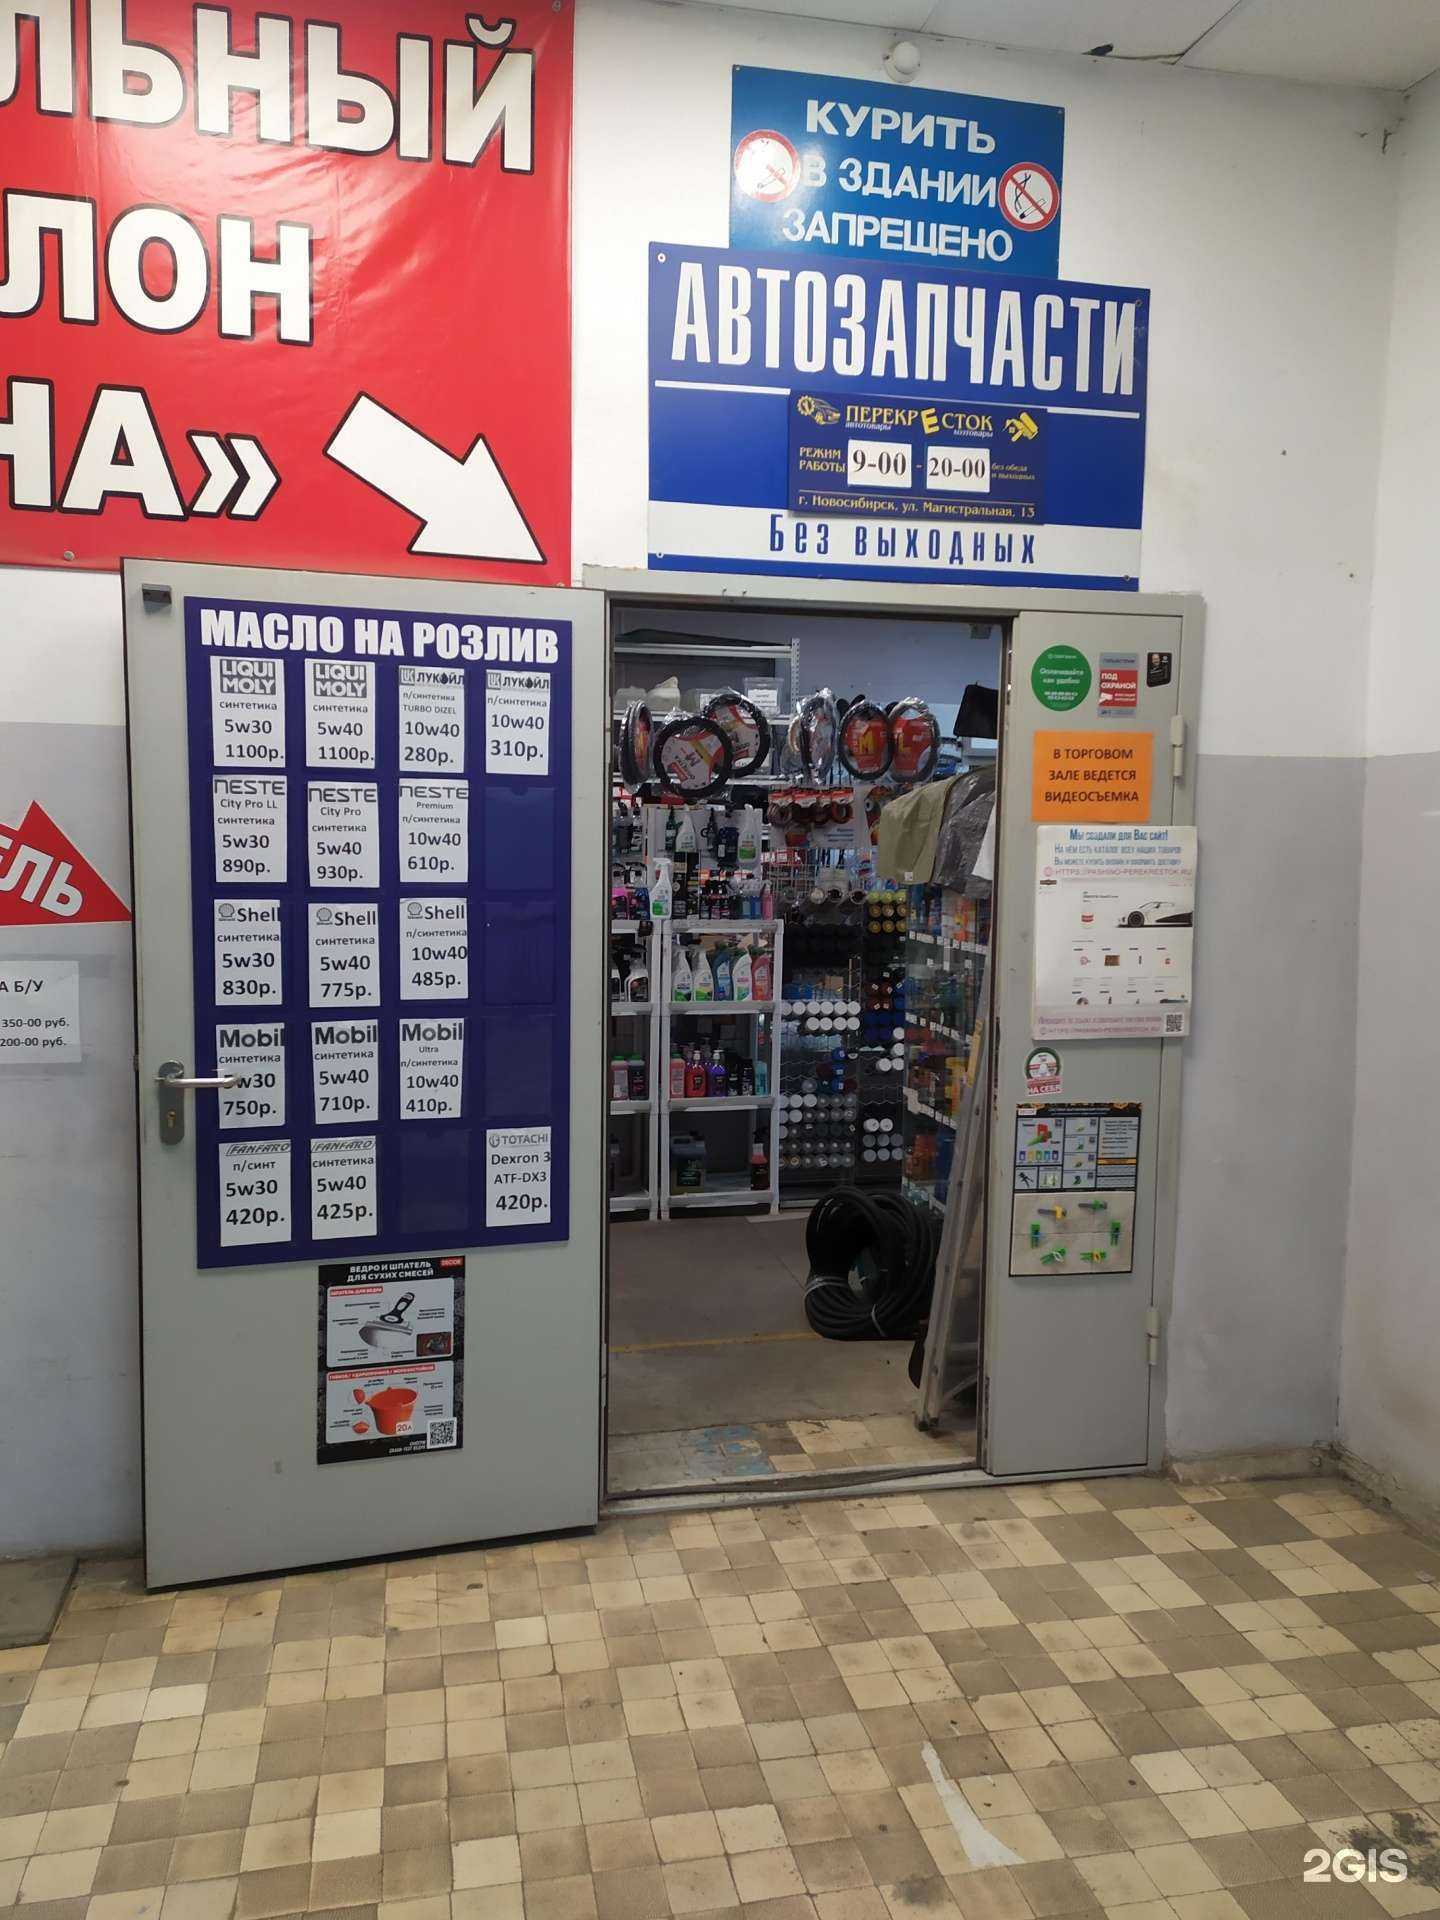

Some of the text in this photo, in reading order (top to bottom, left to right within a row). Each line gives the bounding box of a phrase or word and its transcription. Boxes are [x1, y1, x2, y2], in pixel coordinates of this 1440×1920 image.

[806, 99, 997, 154] КУРИТЬ
[802, 155, 997, 208] В ЗДАНИИ
[782, 208, 1013, 262] ЗАПРЕЩЕНО
[0, 193, 313, 345] ЛОН
[671, 262, 1137, 396] АВТОЗАПЧАСТИ
[846, 405, 993, 434] ПЕРЕКРЕСТОК
[799, 446, 841, 460] РЕЖИМ
[799, 460, 846, 473] РАБОТЫ
[852, 449, 907, 476] 9-00
[928, 457, 986, 480] 20-00
[798, 496, 809, 506] г.
[901, 502, 919, 513] ул.
[769, 514, 1036, 565] Без выходных
[200, 608, 559, 664] МАСЛО НА РОЗЛИВ
[220, 659, 276, 678] LIQUI
[313, 663, 366, 681] LIQUI
[220, 677, 277, 695] MOLY
[313, 680, 367, 699] MOLY
[402, 691, 456, 702] п/синтетика
[487, 696, 547, 707] п/синтетика
[219, 701, 278, 711] синтетика
[313, 704, 369, 713] синтетика
[402, 704, 457, 715] TURBO DIZEL
[224, 719, 273, 735] 5w30
[317, 721, 363, 737] 5w40
[405, 721, 460, 738] 10w40
[491, 714, 545, 730] 10w40
[225, 744, 285, 761] 1100р.
[318, 746, 375, 763] 1100р.
[404, 746, 455, 766] 280р.
[490, 739, 544, 760] 310р.
[1053, 748, 1133, 760] В ТОРГОВОМ
[1049, 769, 1136, 783] ЗАЛЕ ВЕДЕТСЯ
[213, 779, 285, 796] NESTE
[309, 787, 377, 803] NESTE
[400, 785, 468, 800] NESTE
[220, 798, 278, 811] City Pro LL
[416, 801, 454, 810] Premium
[1045, 791, 1139, 805] ВИДЕОСЪЕМКА
[320, 806, 362, 819] City Pro
[402, 815, 461, 825] п/синтетика
[217, 817, 275, 826] синтетика
[312, 824, 367, 833] синтетика
[222, 834, 270, 850] 5w30
[408, 831, 461, 847] 10w40
[317, 841, 362, 856] 5w40
[222, 858, 271, 875] 890р.
[407, 855, 455, 871] 610р.
[317, 865, 363, 881] 930р.
[236, 906, 279, 922] Shell
[334, 910, 377, 926] Shell
[424, 904, 465, 920] Shell
[217, 932, 280, 943] синтетика
[315, 935, 375, 946] синтетика
[405, 928, 467, 938] п/синтетика
[222, 952, 275, 968] 5w30
[411, 945, 467, 961] 10w40
[320, 955, 371, 972] 5w40
[14, 979, 44, 995] Б/У
[411, 971, 462, 987] 485р.
[222, 979, 276, 996] 830р.
[320, 982, 372, 998] 775р.
[1, 1017, 70, 1029] 350-00 руб.
[219, 1028, 284, 1048] Mobil
[314, 1026, 378, 1045] Mobil
[401, 1023, 464, 1042] Mobil
[0, 1035, 67, 1048] 200-00 руб.
[419, 1045, 439, 1053] Ultra
[218, 1053, 281, 1064] синтетика
[314, 1050, 374, 1061] синтетика
[400, 1058, 459, 1068] п/синтетика
[319, 1069, 369, 1085] 5w40
[406, 1074, 459, 1089] 10w40
[223, 1100, 277, 1117] 750р.
[319, 1096, 371, 1112] 710р.
[405, 1098, 452, 1114] 410р.
[501, 1133, 548, 1145] TOTACHI
[312, 1156, 374, 1168] синтетика
[491, 1151, 551, 1165] Dexron 3
[232, 1160, 275, 1174] п/синт
[317, 1176, 367, 1193] 5w40
[494, 1171, 547, 1185] ATF-DX3
[226, 1180, 278, 1197] 5w30
[495, 1194, 549, 1212] 420р.
[226, 1207, 285, 1226] 420р.
[317, 1203, 373, 1221] 425р.
[350, 1265, 380, 1273] ВЕДРО
[389, 1261, 432, 1270] ШПАТЕЛЬ
[347, 1268, 434, 1283] ДЛЯ СУХИХ СМЕСЕЙ
